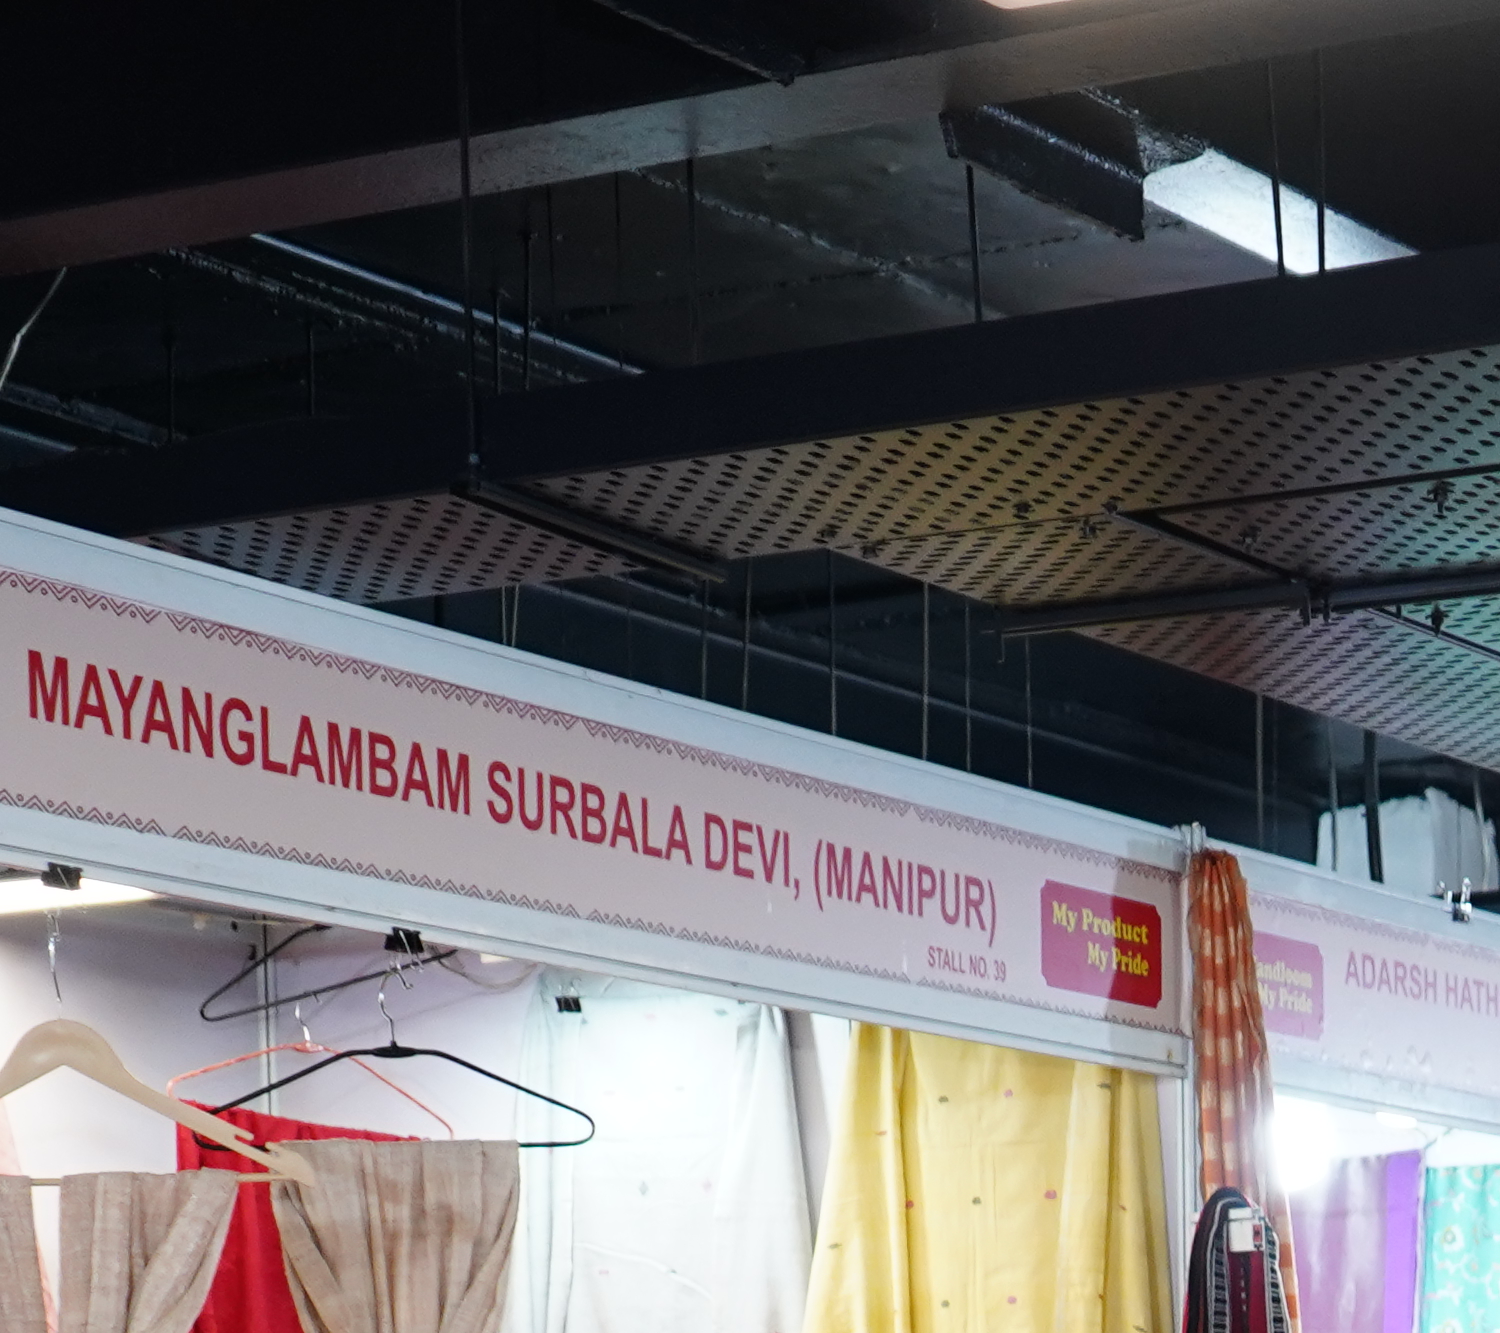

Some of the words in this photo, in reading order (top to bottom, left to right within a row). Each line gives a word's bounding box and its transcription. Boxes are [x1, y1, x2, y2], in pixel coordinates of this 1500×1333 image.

[27, 649, 471, 816] MAYANGLAMBAM
[486, 760, 693, 867] SURBALA
[703, 811, 801, 900] DEVI,
[813, 838, 998, 948] (MANIPUR)
[1052, 899, 1077, 933] My
[1081, 907, 1149, 945] Product
[927, 945, 966, 975] STALL
[969, 955, 990, 979] NO.
[993, 959, 1007, 983] 39
[1087, 940, 1108, 973] My
[1111, 946, 1149, 977] Pride
[1254, 957, 1313, 989] andloom
[1345, 951, 1438, 1005] ADARSH
